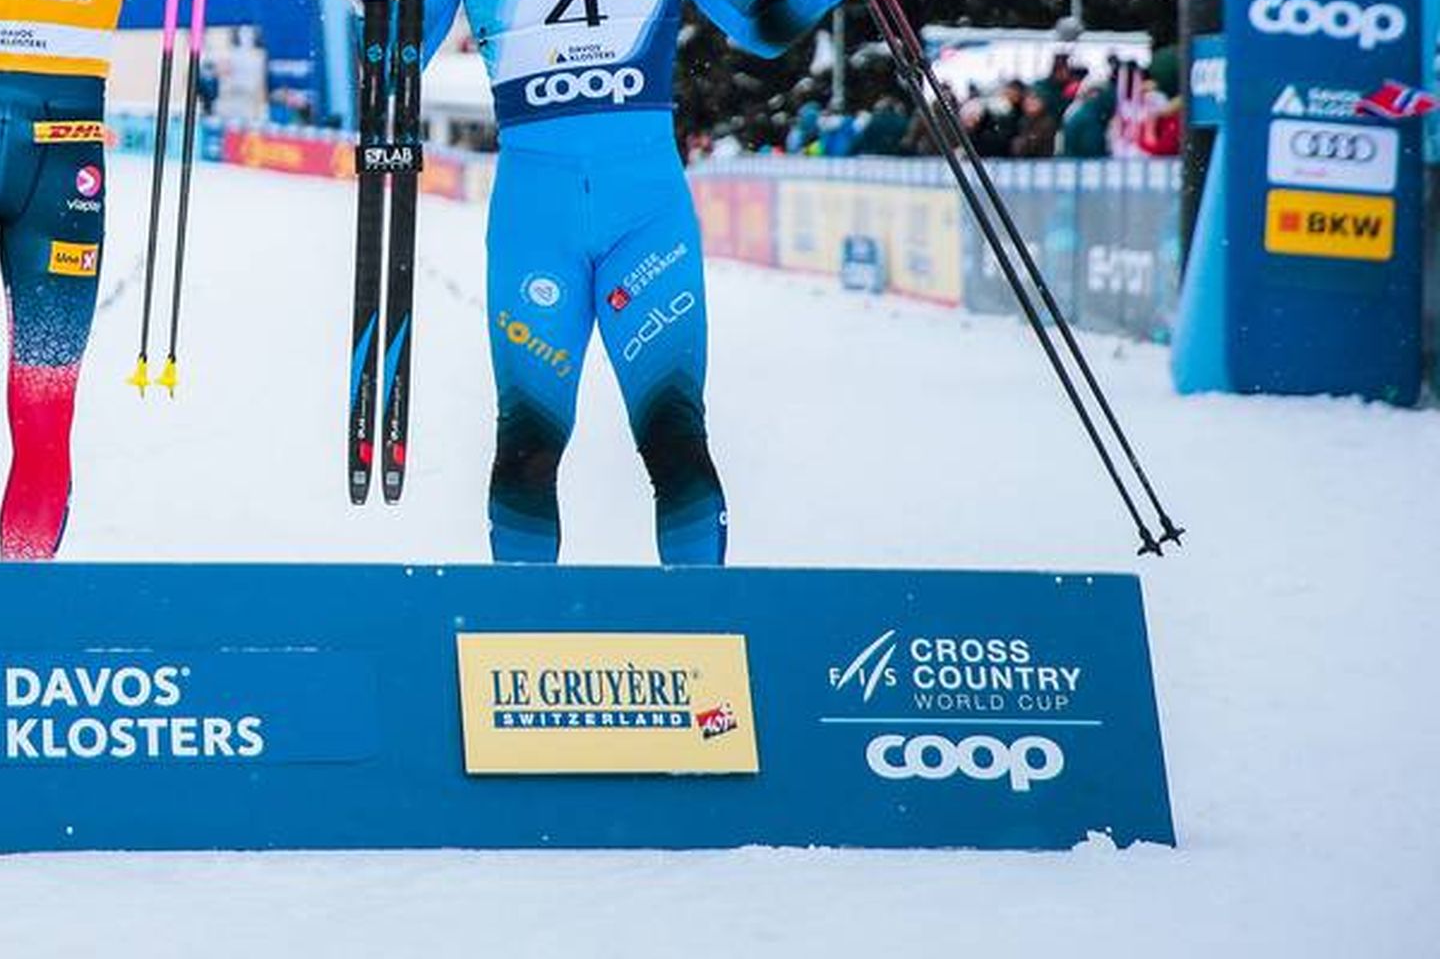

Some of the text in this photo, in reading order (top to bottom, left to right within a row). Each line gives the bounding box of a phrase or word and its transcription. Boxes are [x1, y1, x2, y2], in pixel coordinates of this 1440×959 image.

[525, 67, 646, 106] coop
[1306, 212, 1381, 238] BKW
[497, 311, 572, 377] somfy
[910, 638, 1032, 663] CROSS
[5, 667, 182, 707] DAVOS
[491, 669, 530, 706] LE
[912, 666, 1082, 691] COUNTRY
[502, 713, 683, 726] SWITZERLAND
[913, 694, 1070, 711] WORLD CUP
[6, 717, 265, 758] KLOSTERS
[865, 734, 1065, 791] coop
